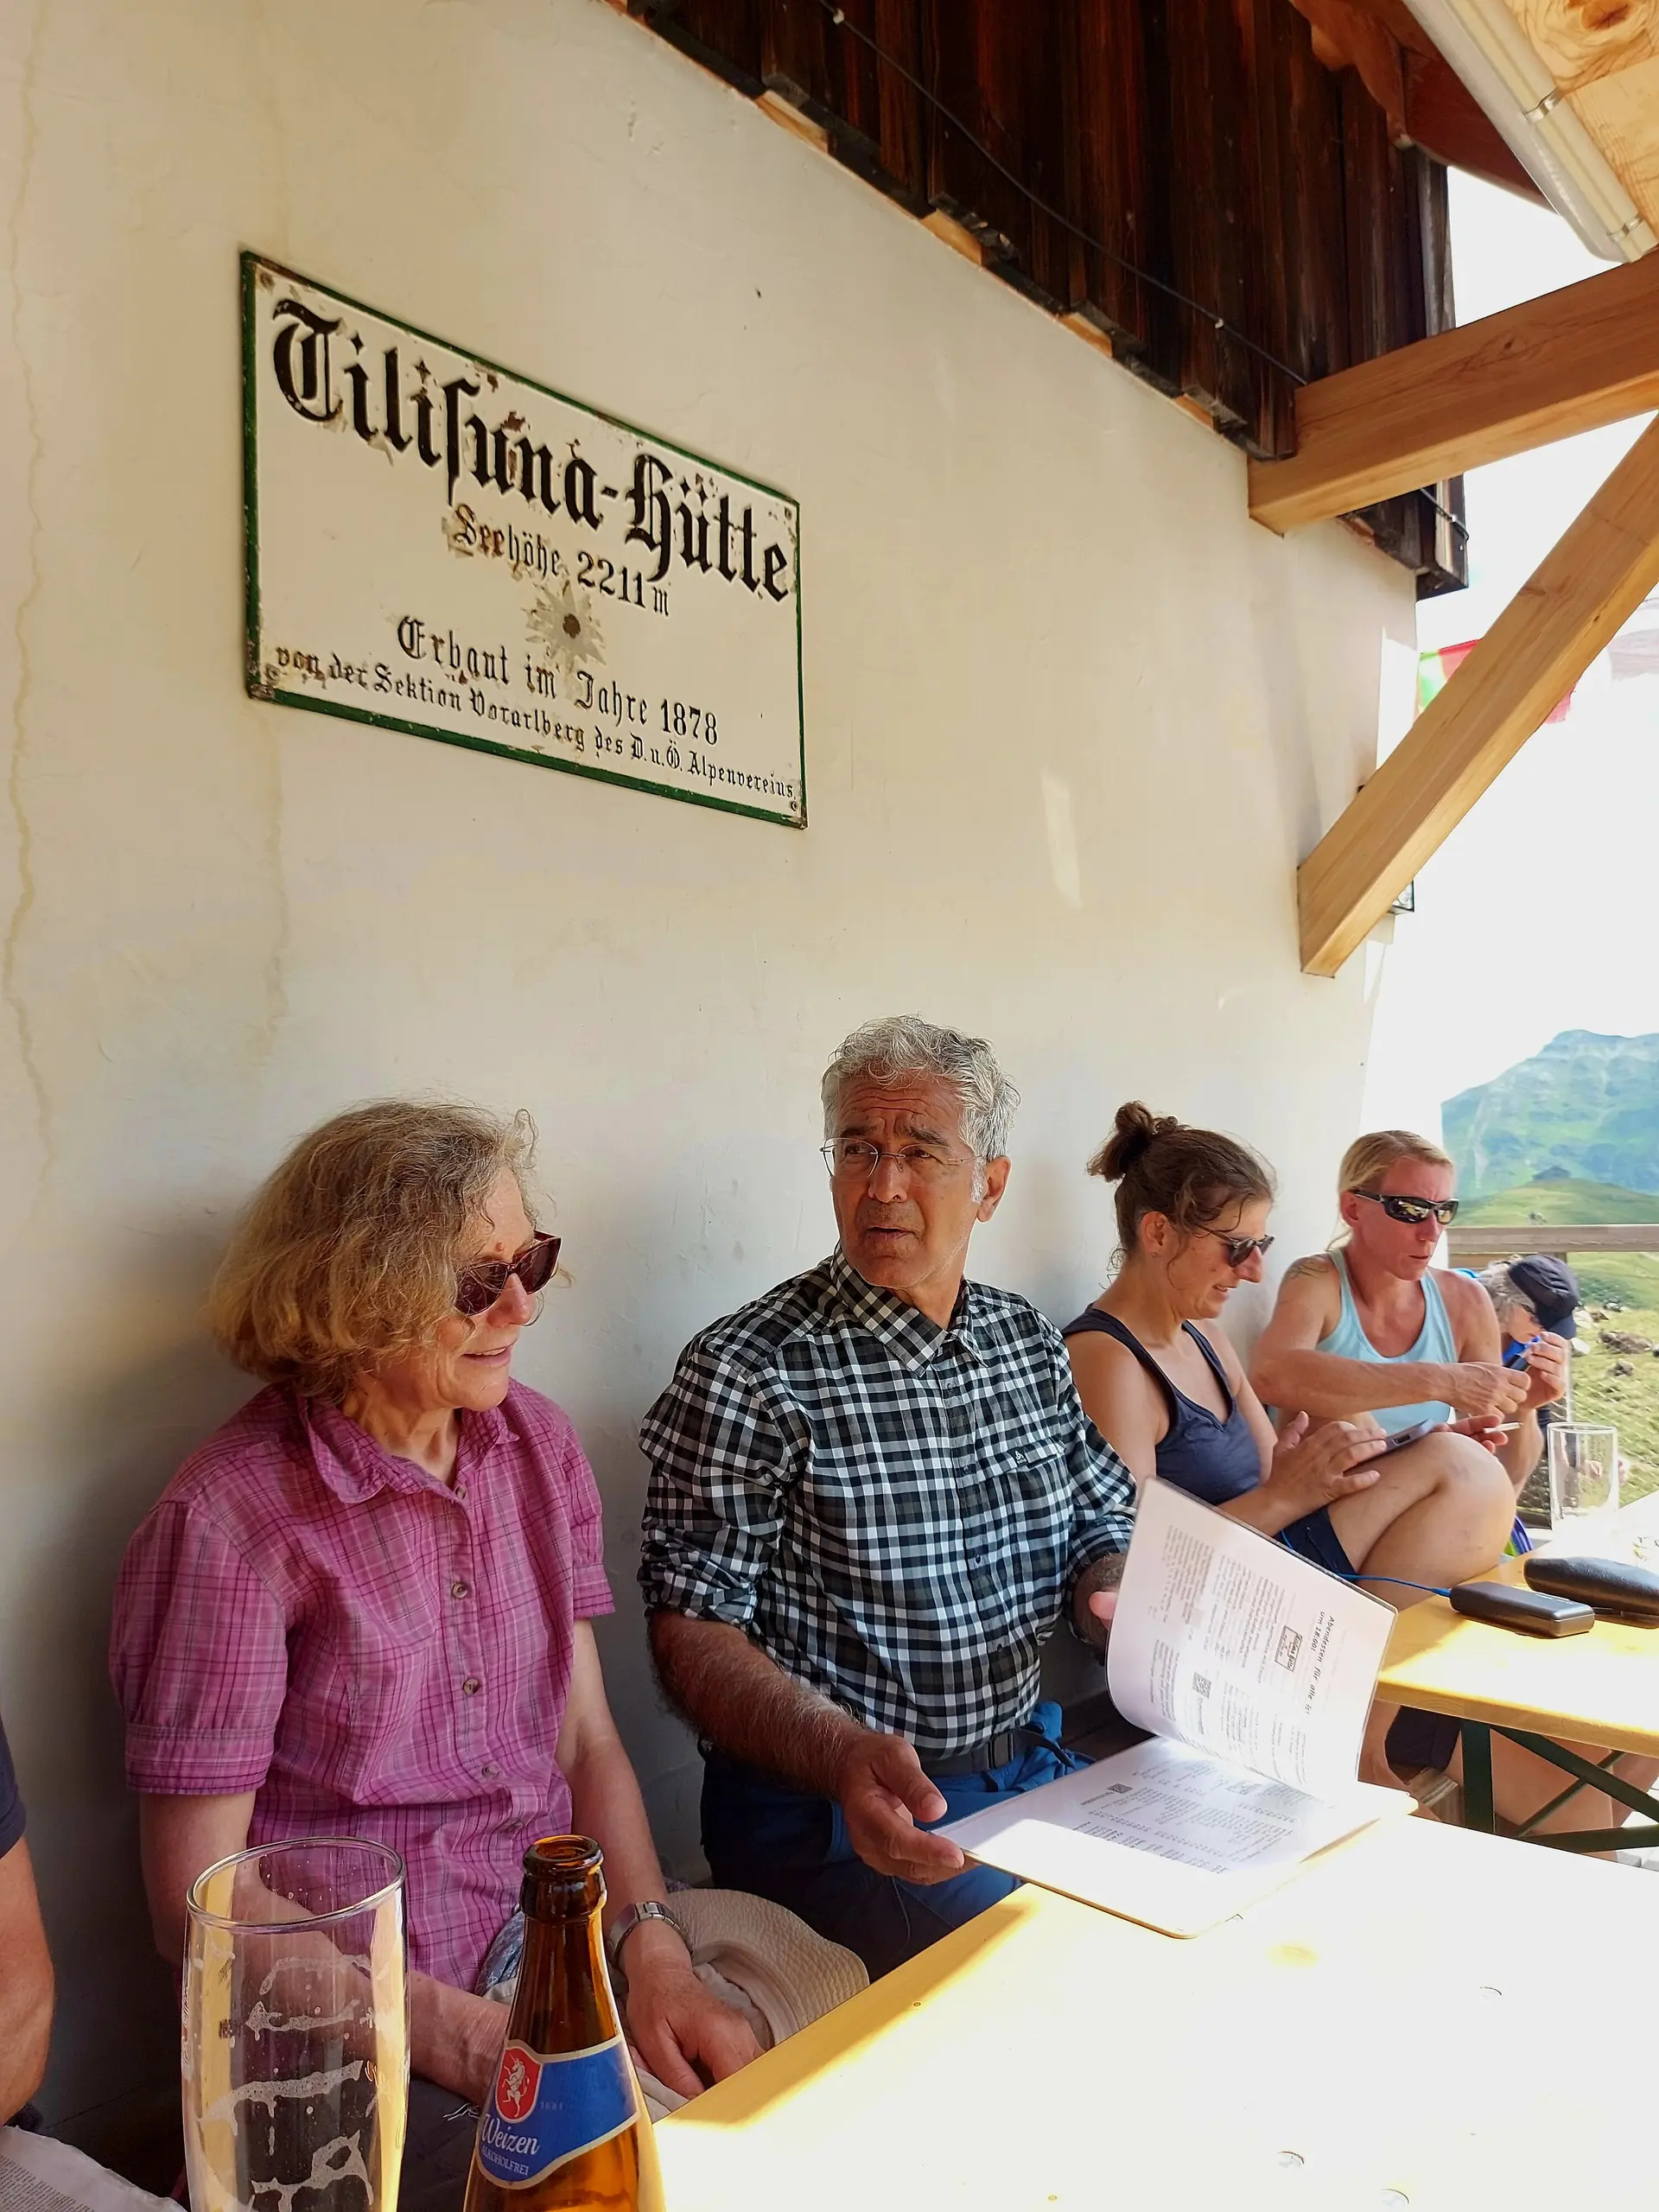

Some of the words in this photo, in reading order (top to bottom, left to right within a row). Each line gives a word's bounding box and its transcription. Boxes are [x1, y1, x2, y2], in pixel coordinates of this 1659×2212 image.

[454, 504, 561, 578] Seehöhe
[276, 646, 320, 676] von
[329, 653, 368, 689] der
[373, 663, 462, 712] Sektion
[469, 688, 585, 752] Vorarlberg
[594, 725, 624, 755] des
[397, 615, 510, 686] Erbaut
[525, 655, 557, 699] im
[574, 670, 649, 728] Jahre
[660, 698, 719, 747] 1878
[1317, 1611, 1325, 1624] um
[1317, 1615, 1336, 1663] Abendessen
[1307, 1684, 1316, 1700] alle
[1313, 1666, 1322, 1681] für
[481, 2113, 541, 2156] Weizen
